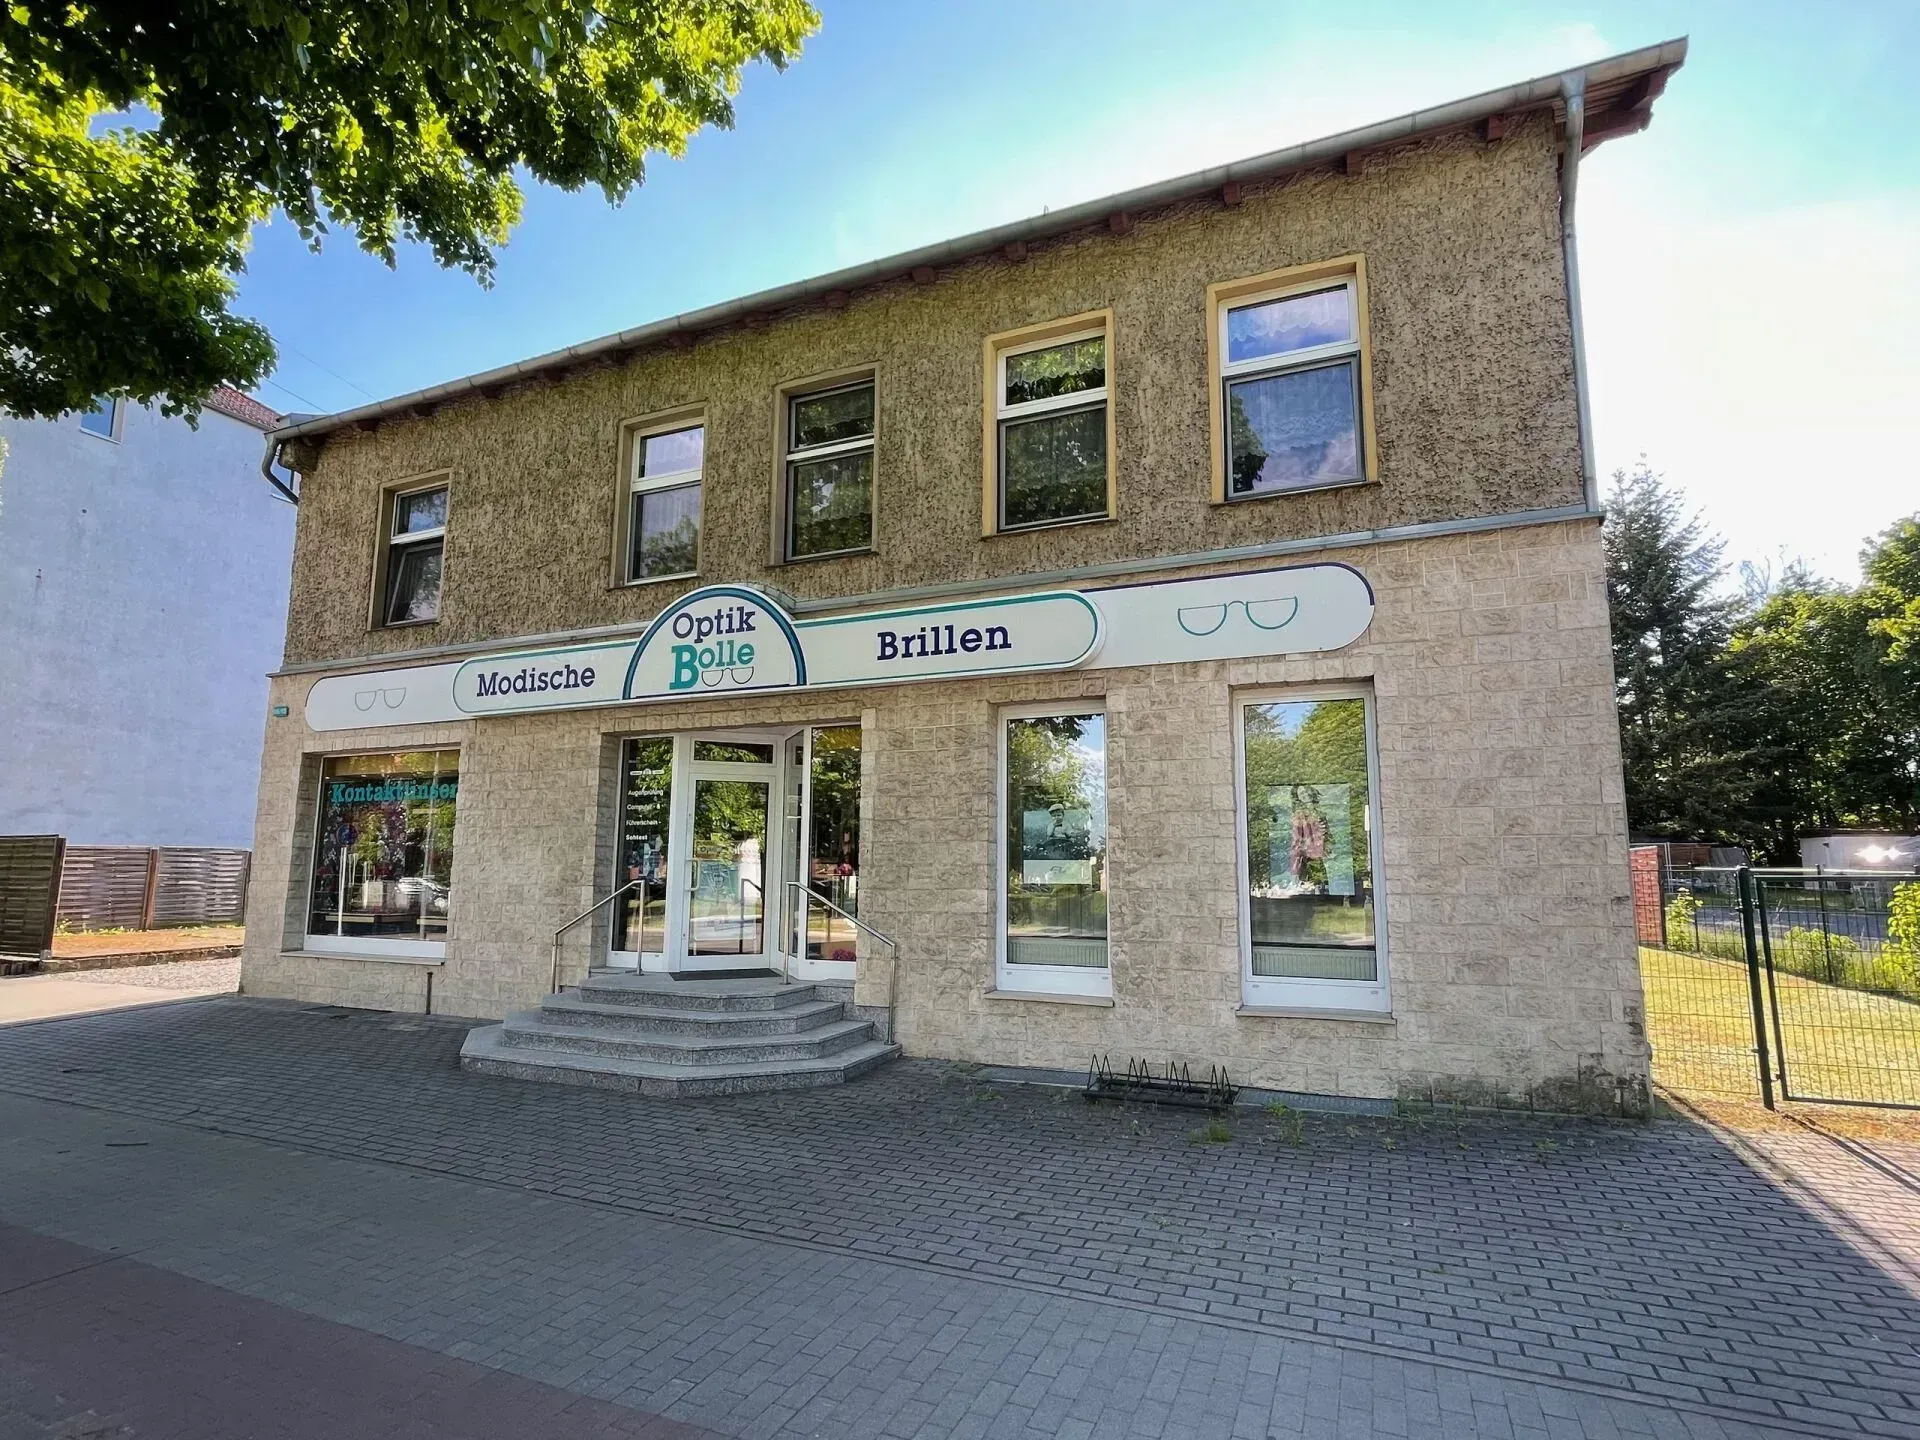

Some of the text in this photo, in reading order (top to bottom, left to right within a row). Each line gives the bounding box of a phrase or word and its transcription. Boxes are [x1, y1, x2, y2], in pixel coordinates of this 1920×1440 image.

[672, 606, 756, 643] Optik
[876, 624, 1012, 661] Brillen
[476, 664, 596, 697] Modische
[669, 639, 755, 690] Bolle
